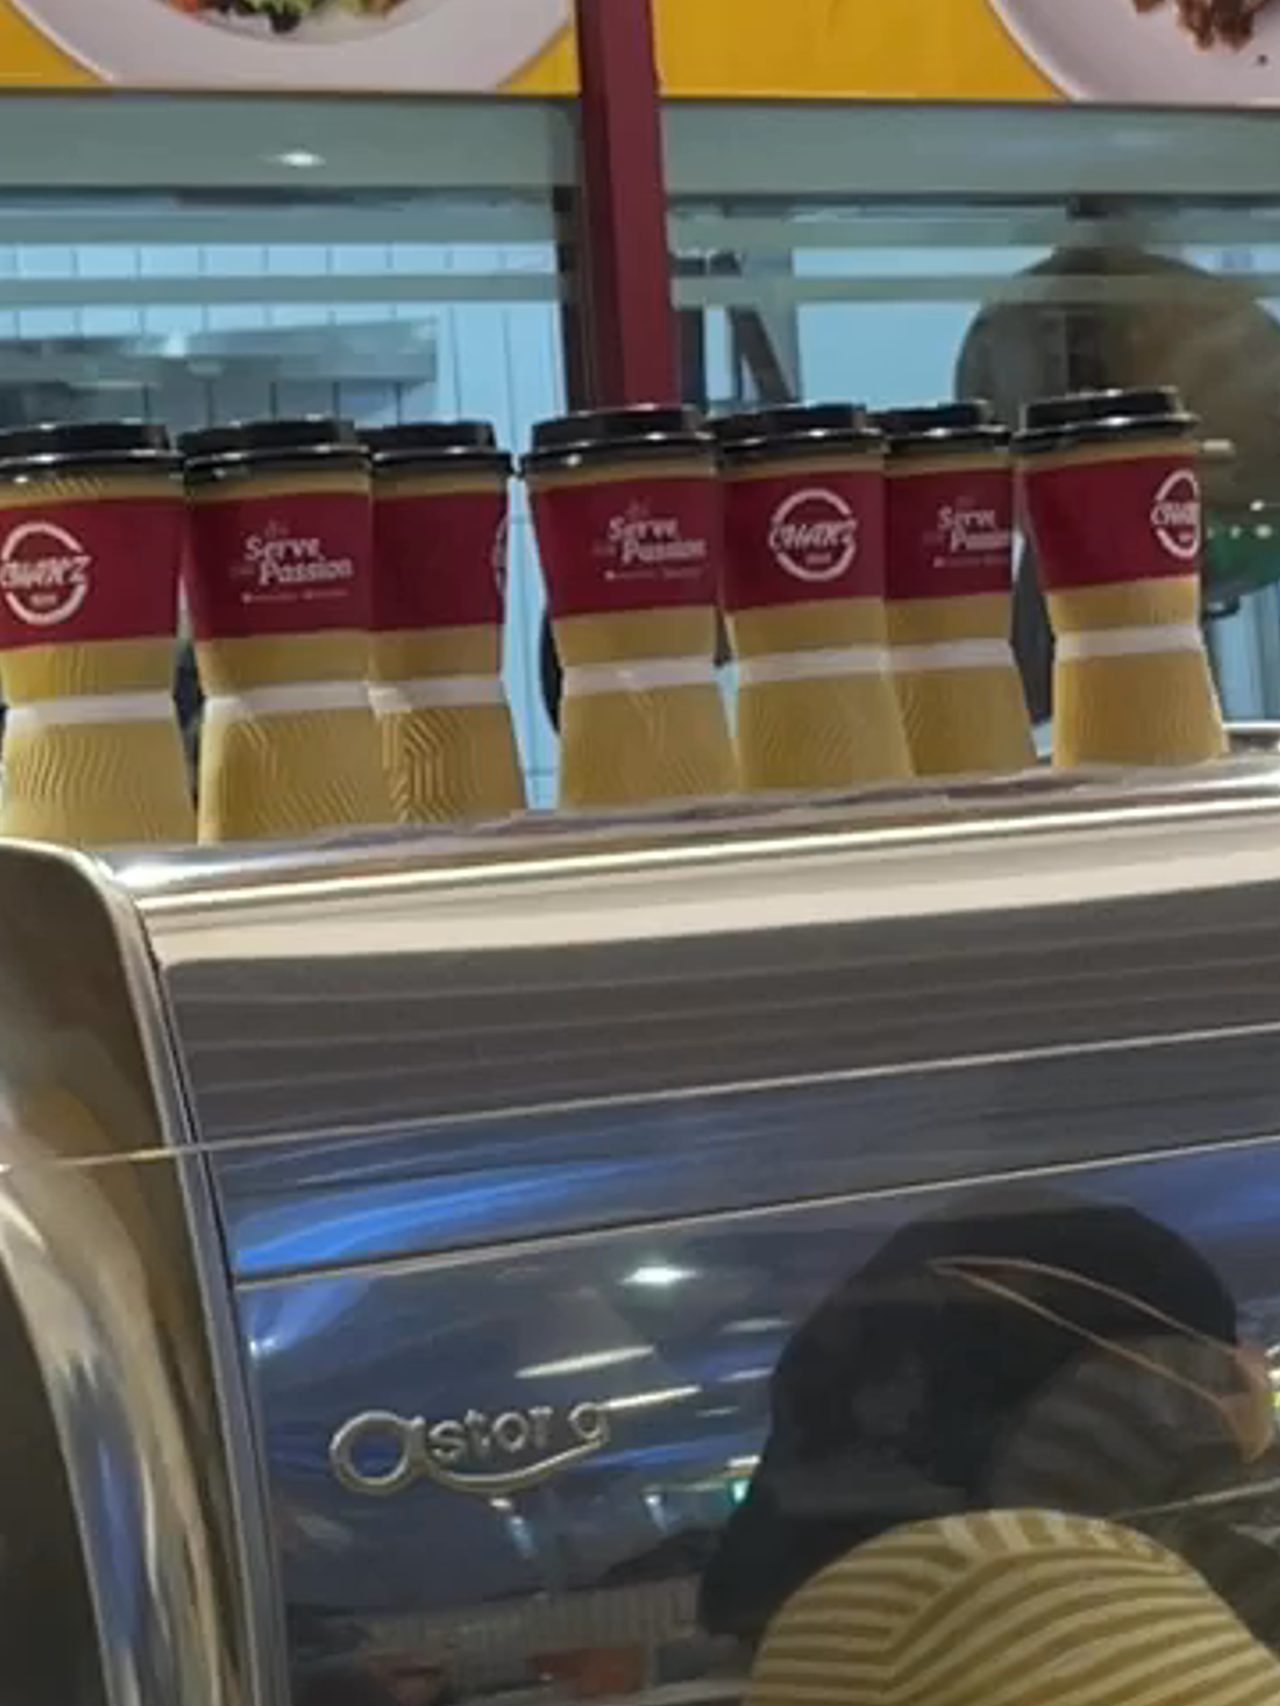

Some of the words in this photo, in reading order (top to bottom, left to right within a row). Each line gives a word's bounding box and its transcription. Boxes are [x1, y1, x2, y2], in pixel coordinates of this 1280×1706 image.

[608, 516, 679, 542] Serve
[244, 535, 322, 562] Serve
[260, 556, 354, 586] Passion
